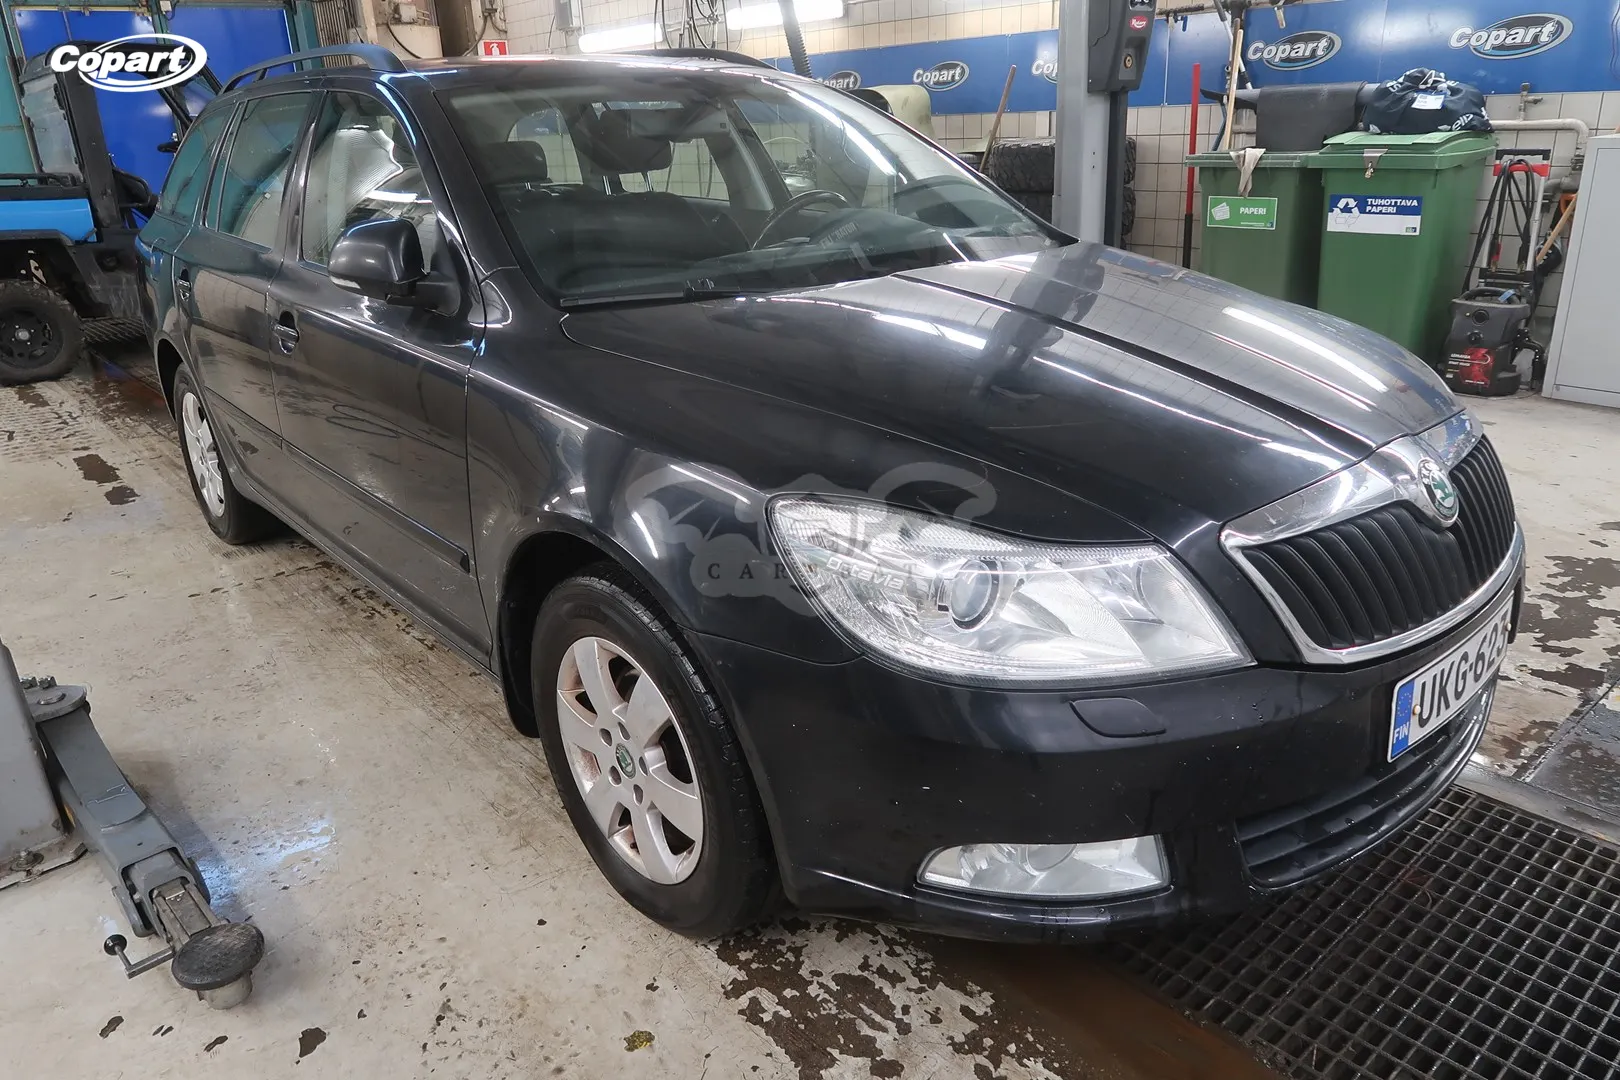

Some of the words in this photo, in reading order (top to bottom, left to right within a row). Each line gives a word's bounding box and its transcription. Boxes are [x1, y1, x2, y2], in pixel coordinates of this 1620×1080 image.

[1449, 18, 1556, 47] Copart
[1247, 37, 1328, 63] Copart
[912, 63, 965, 87] Copart
[1239, 206, 1267, 215] PAPERI
[1366, 198, 1418, 206] TUHOTTAVA
[826, 556, 904, 590] Octavia
[1418, 608, 1509, 728] UKG-623
[1393, 722, 1409, 743] FIN
